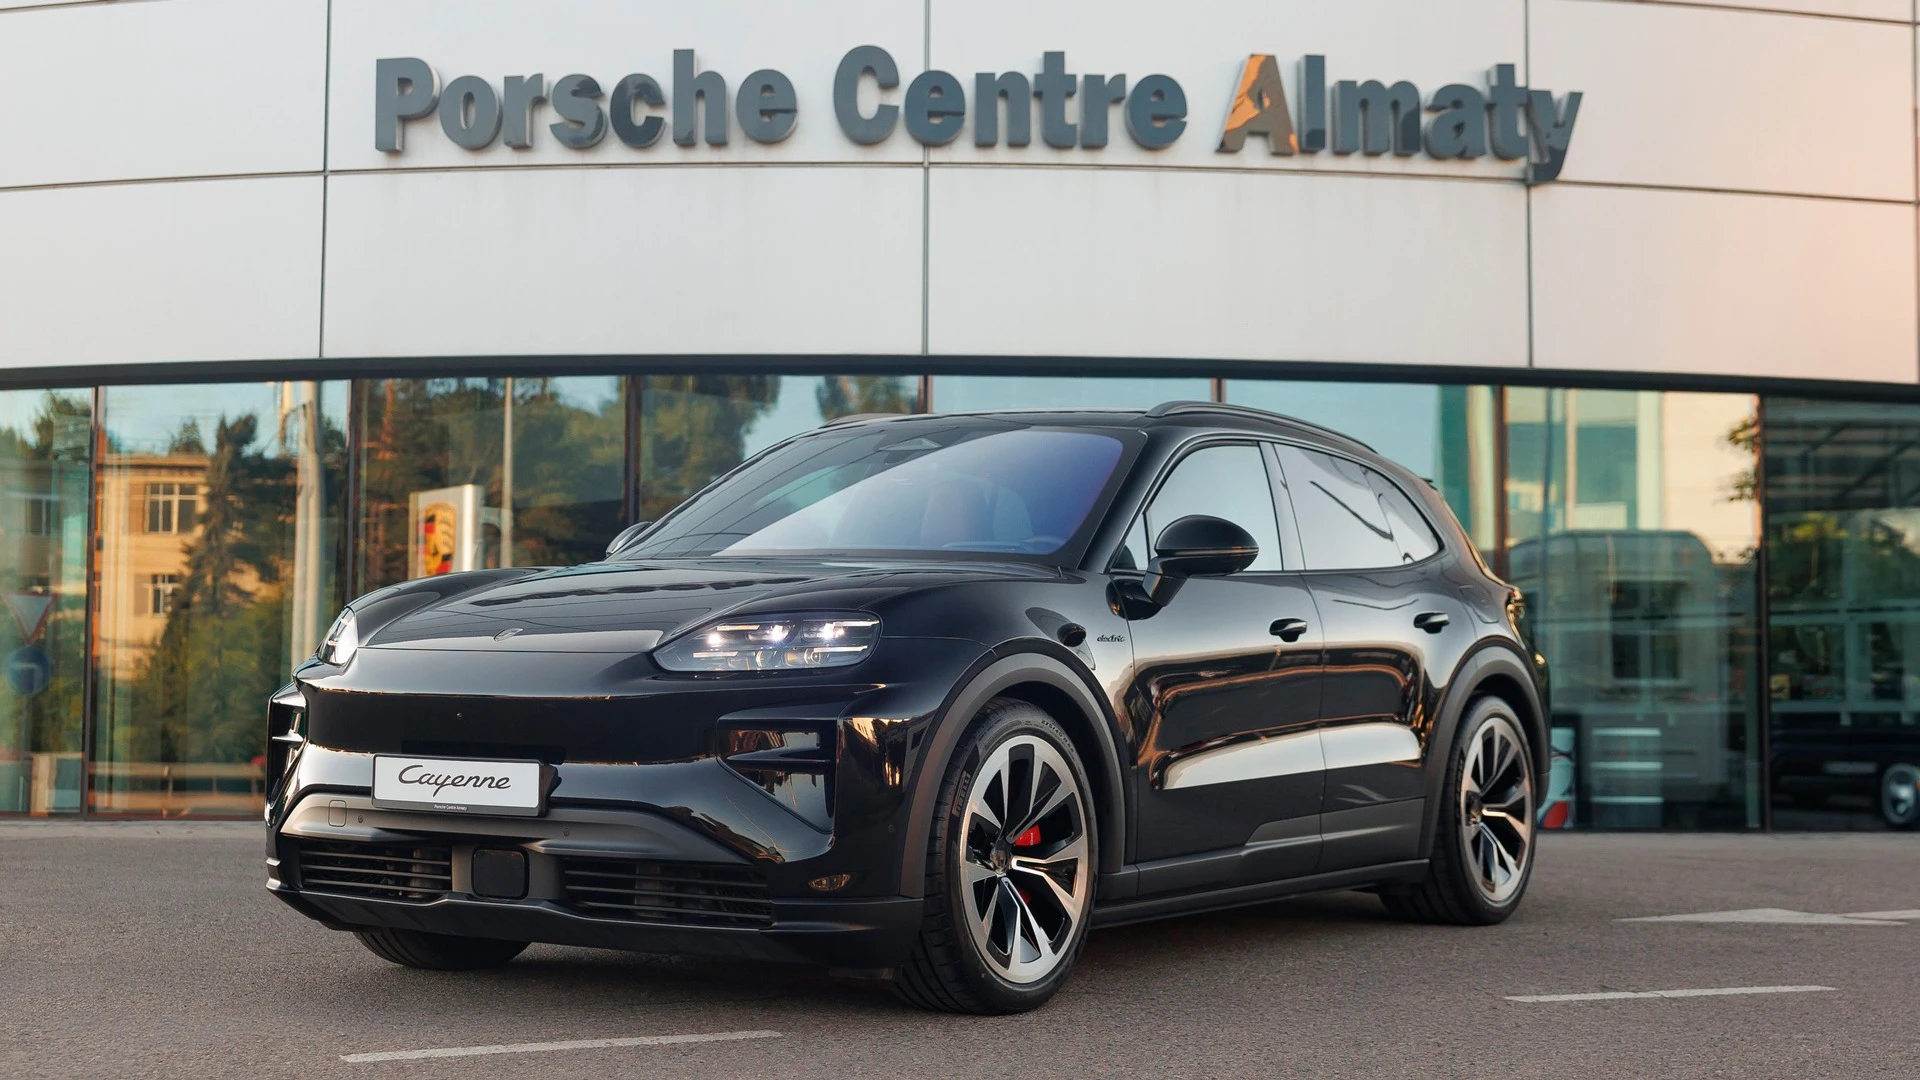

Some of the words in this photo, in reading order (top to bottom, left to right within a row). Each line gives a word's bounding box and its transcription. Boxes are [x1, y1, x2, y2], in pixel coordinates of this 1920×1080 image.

[375, 48, 798, 153] Porsche
[833, 44, 1188, 151] Centre
[1216, 52, 1583, 183] Almaty
[1097, 634, 1126, 642] electric
[398, 764, 511, 797] Cayenne
